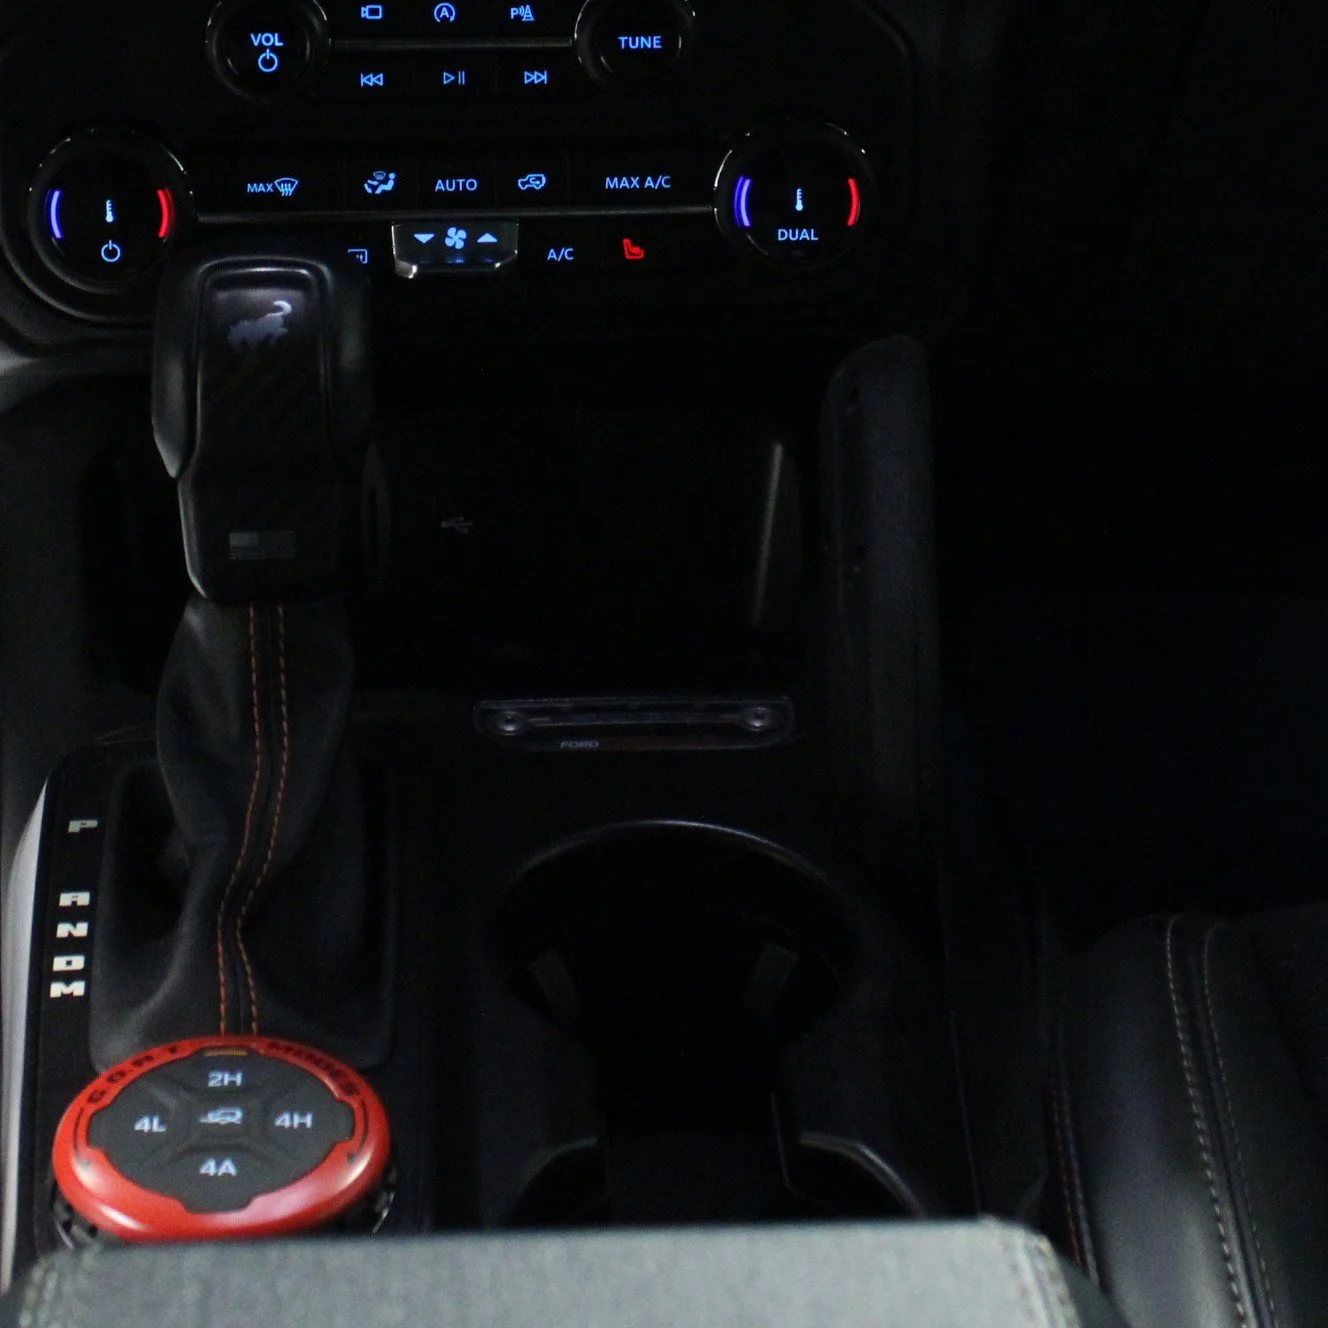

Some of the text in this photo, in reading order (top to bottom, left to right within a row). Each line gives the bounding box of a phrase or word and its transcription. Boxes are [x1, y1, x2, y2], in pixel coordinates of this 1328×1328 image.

[250, 33, 284, 47] VOL
[618, 35, 662, 50] TUNE
[247, 183, 274, 194] MAX
[435, 178, 478, 192] AUTO
[605, 175, 671, 189] MAX A/C
[777, 228, 819, 241] DUAL
[547, 248, 574, 261] A/C
[68, 819, 98, 833] P
[56, 922, 88, 938] N
[53, 954, 85, 972] D
[50, 980, 86, 998] M
[208, 1071, 243, 1087] 2H
[134, 1117, 168, 1133] 4L
[274, 1112, 313, 1129] 4H
[199, 1159, 238, 1177] 4A
